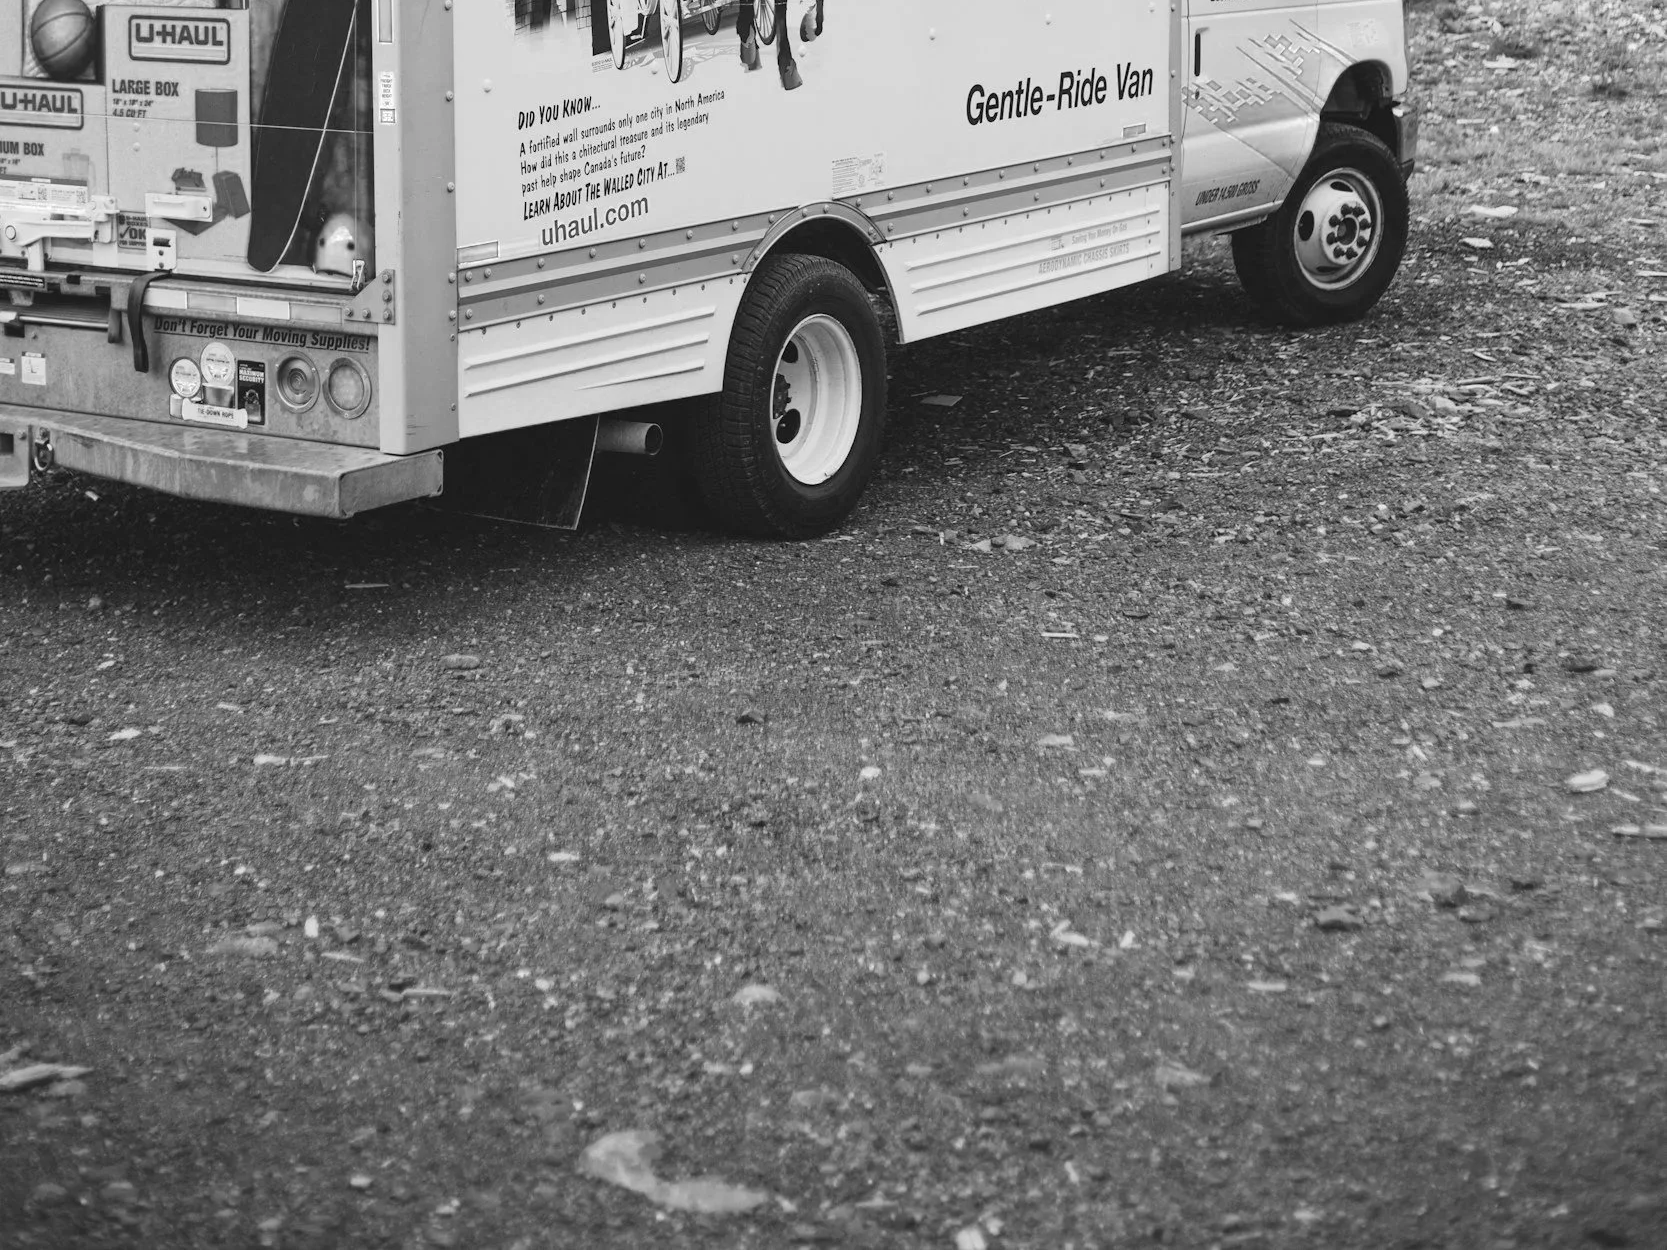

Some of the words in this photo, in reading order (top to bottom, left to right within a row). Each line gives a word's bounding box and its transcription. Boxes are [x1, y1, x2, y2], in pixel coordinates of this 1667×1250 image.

[135, 23, 224, 47] U-HAUL
[1, 91, 78, 114] U-HAUL
[112, 79, 150, 95] LARGE
[155, 81, 179, 97] BOX
[965, 69, 1107, 126] Gentle-Ride
[1116, 62, 1154, 101] Van
[137, 109, 146, 119] FT
[518, 111, 535, 130] DID
[539, 104, 559, 124] YOU
[563, 96, 601, 118] KNOW...
[520, 142, 526, 157] A
[529, 132, 560, 154] fortified
[563, 128, 578, 144] wall
[581, 118, 616, 140] surrounds
[619, 113, 633, 128] only
[636, 112, 648, 124] one
[651, 107, 663, 120] city
[666, 103, 673, 114] in
[675, 95, 694, 113] North
[697, 89, 725, 107] America
[23, 142, 45, 156] BOX
[521, 160, 537, 175] How
[541, 154, 552, 169] did
[555, 151, 569, 165] this
[620, 130, 648, 146] treasure
[651, 122, 663, 137] and
[666, 121, 675, 132] its
[677, 111, 709, 131] legendary
[521, 179, 538, 197] past
[541, 172, 556, 188] help
[560, 168, 581, 182] shape
[584, 154, 618, 176] Canada's
[620, 144, 646, 165] future?
[523, 197, 551, 221] LEARN
[553, 187, 582, 211] ABOUT
[585, 182, 601, 202] THE
[604, 173, 634, 197] WALLED
[637, 167, 655, 186] CITY
[657, 161, 675, 180] AT...
[1195, 187, 1220, 206] UNDER
[1236, 179, 1260, 198] GROSS
[128, 228, 146, 240] OK
[541, 197, 649, 246] uhaul.com
[1039, 254, 1081, 273] AERODYNAMIC
[1083, 247, 1109, 264] CHASSIS
[1110, 243, 1129, 258] SKIRTS
[154, 317, 186, 332] Don't
[190, 320, 228, 338] Forget
[232, 324, 259, 340] Your
[262, 327, 307, 347] Moving
[311, 332, 371, 351] Supplies!
[239, 375, 264, 383] SECURITY
